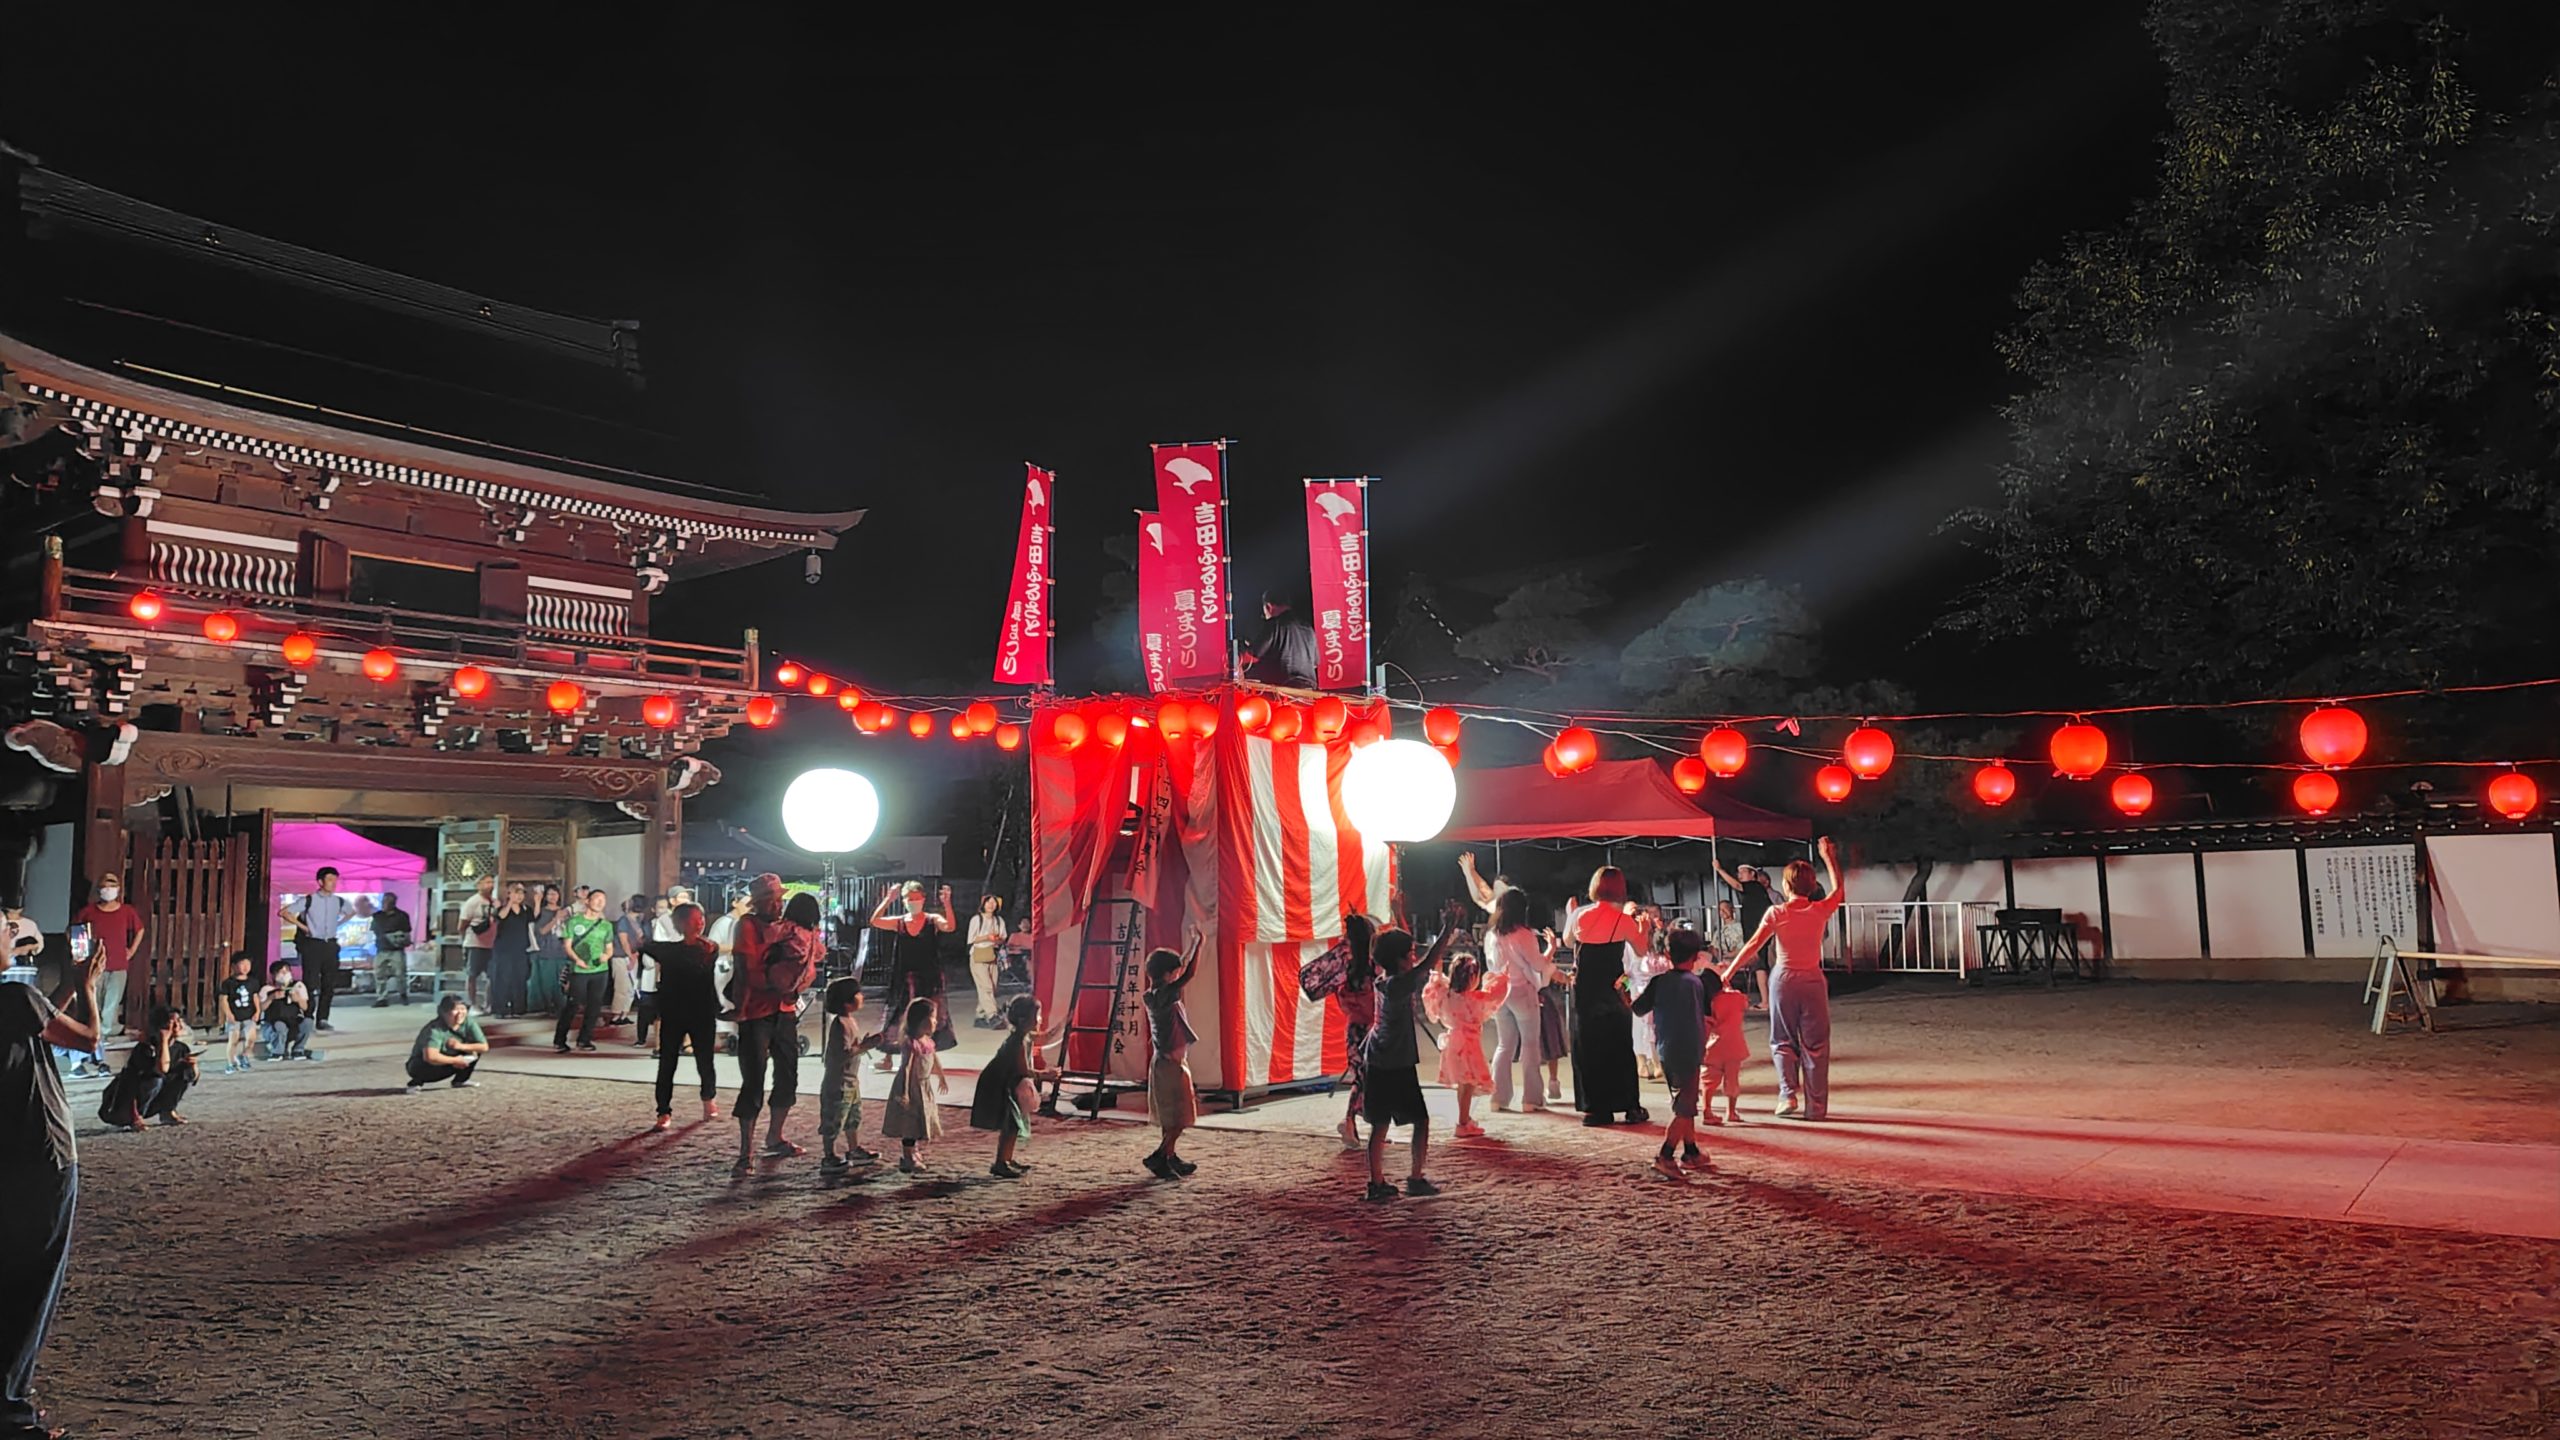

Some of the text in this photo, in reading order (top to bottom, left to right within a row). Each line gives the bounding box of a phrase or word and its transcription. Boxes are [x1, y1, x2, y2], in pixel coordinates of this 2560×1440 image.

[1024, 523, 1044, 637] 吉田ふるさと
[1194, 501, 1218, 624] 吉田ふるさと
[1338, 531, 1362, 642] 吉田ふるさと
[1002, 600, 1022, 675] 夏まつり
[1174, 588, 1197, 669] 夏まつり
[1321, 609, 1344, 682] 夏まつり
